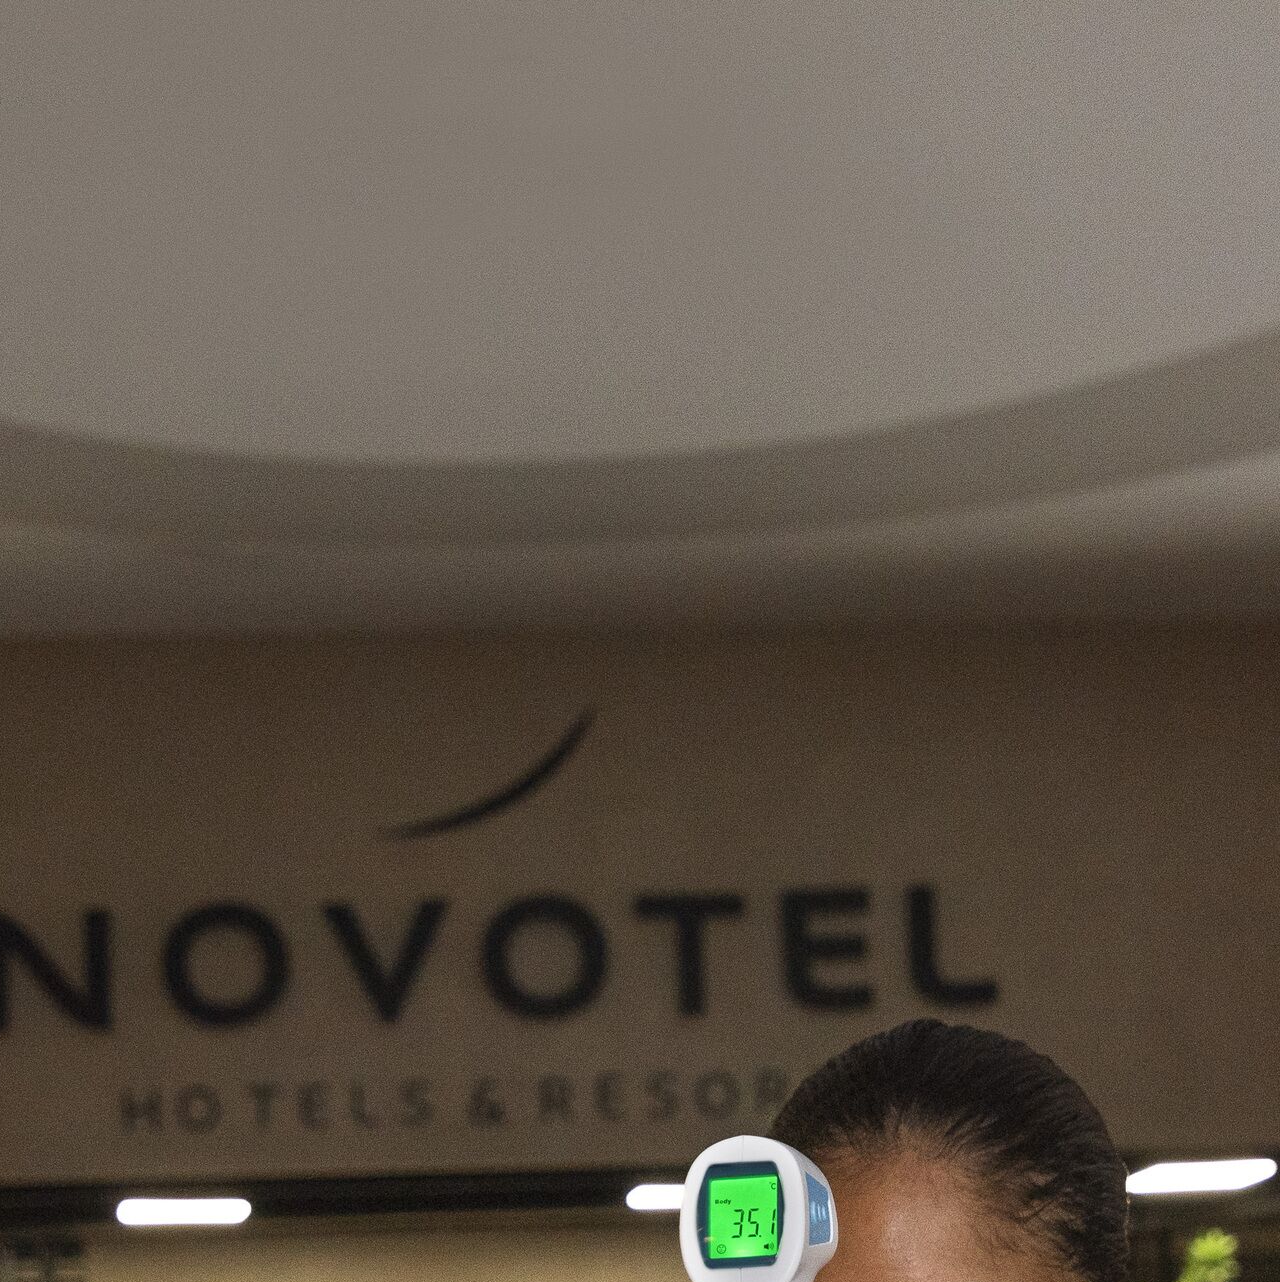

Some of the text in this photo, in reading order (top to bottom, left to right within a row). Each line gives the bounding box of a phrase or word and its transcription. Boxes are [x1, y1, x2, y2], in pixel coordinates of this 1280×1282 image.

[121, 1077, 436, 1136] HOTELS
[467, 1075, 508, 1129] &
[732, 1208, 776, 1238] 35.1
